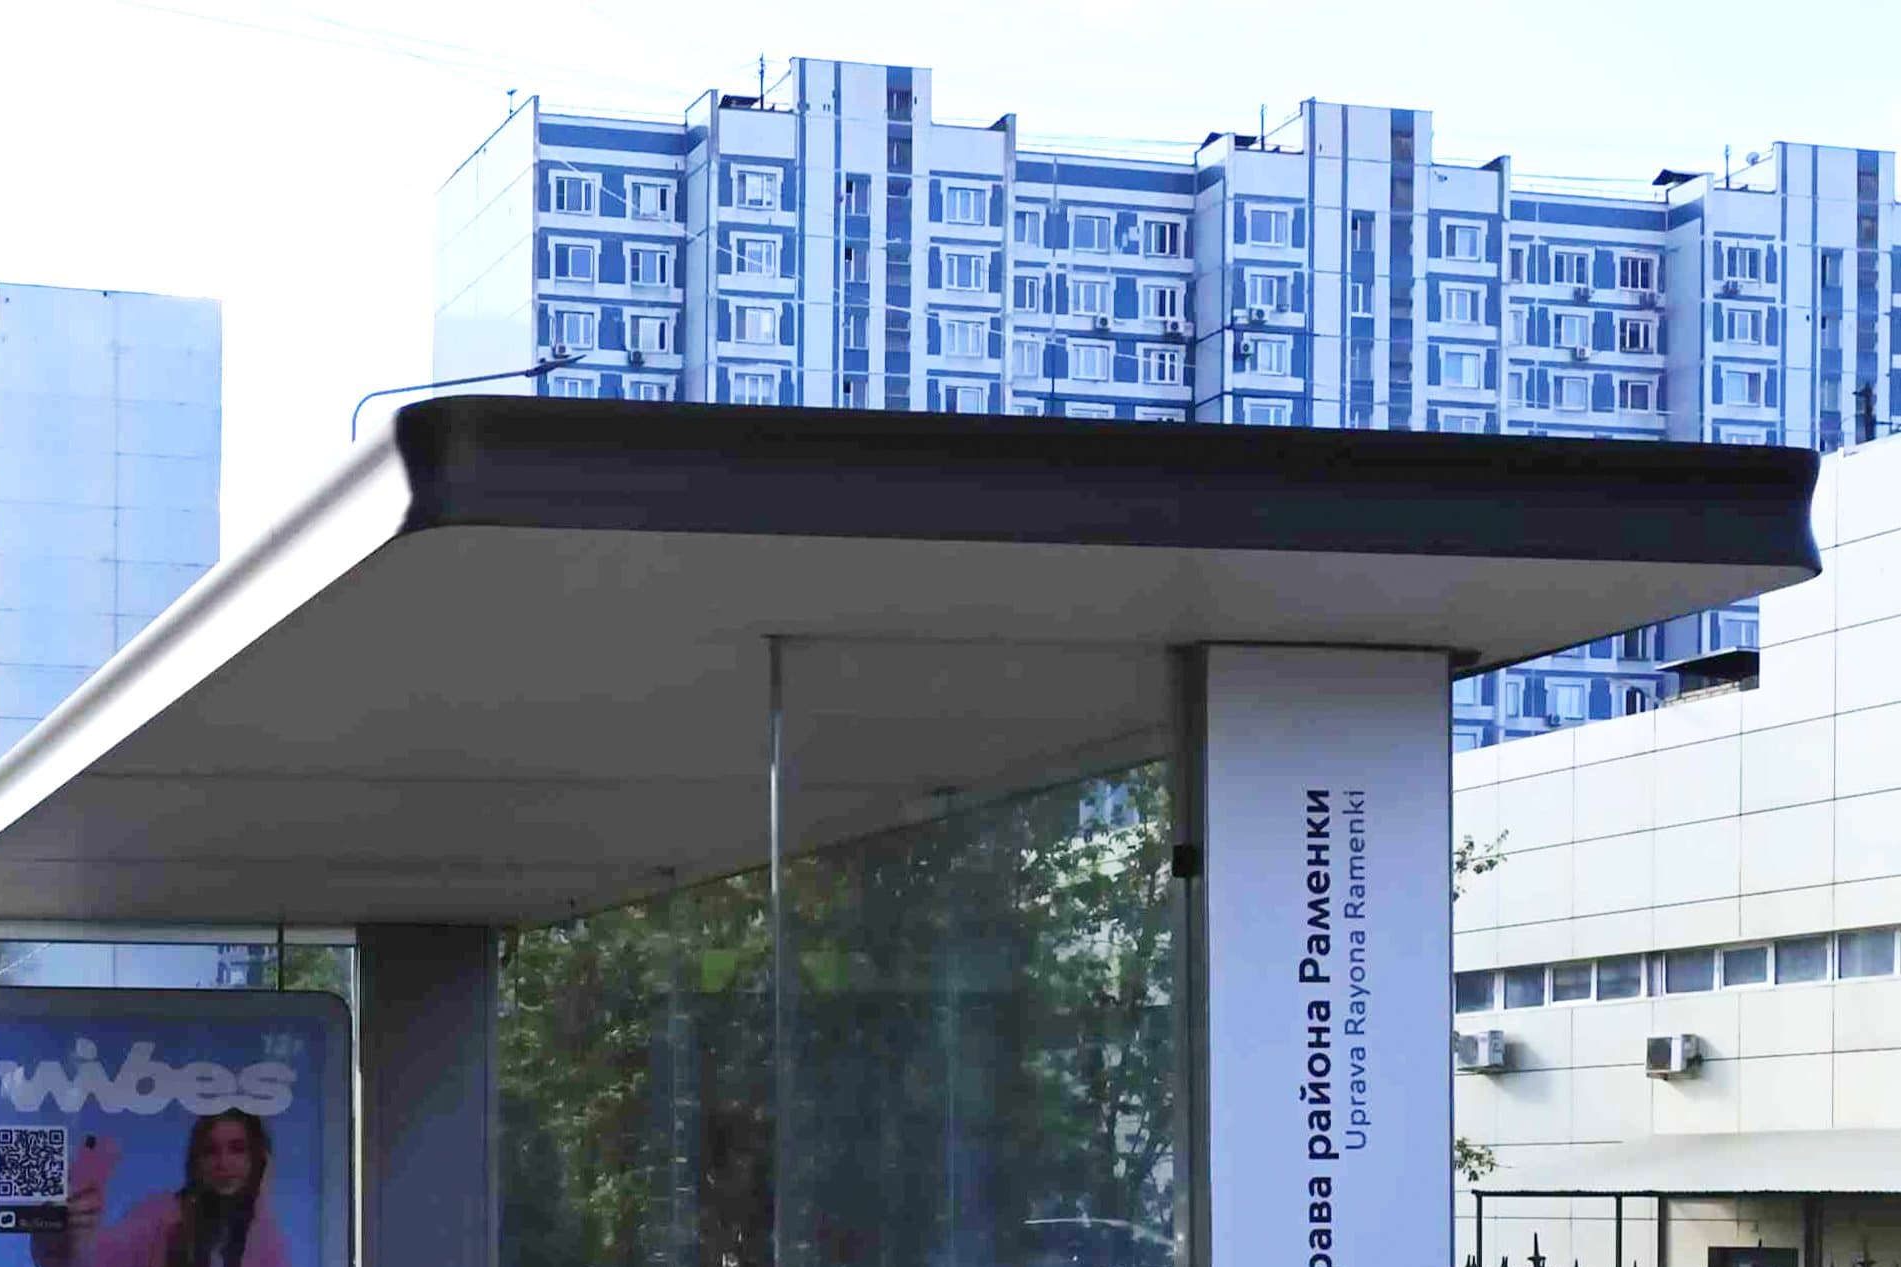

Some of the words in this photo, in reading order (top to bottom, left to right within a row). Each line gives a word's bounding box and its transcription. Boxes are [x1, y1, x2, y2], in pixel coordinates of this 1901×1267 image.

[1298, 789, 1331, 984] Раменки
[1342, 790, 1366, 919] Ramenki
[1344, 930, 1371, 1035] Rayona
[1299, 1000, 1339, 1160] района
[1345, 1046, 1371, 1150] Uprava
